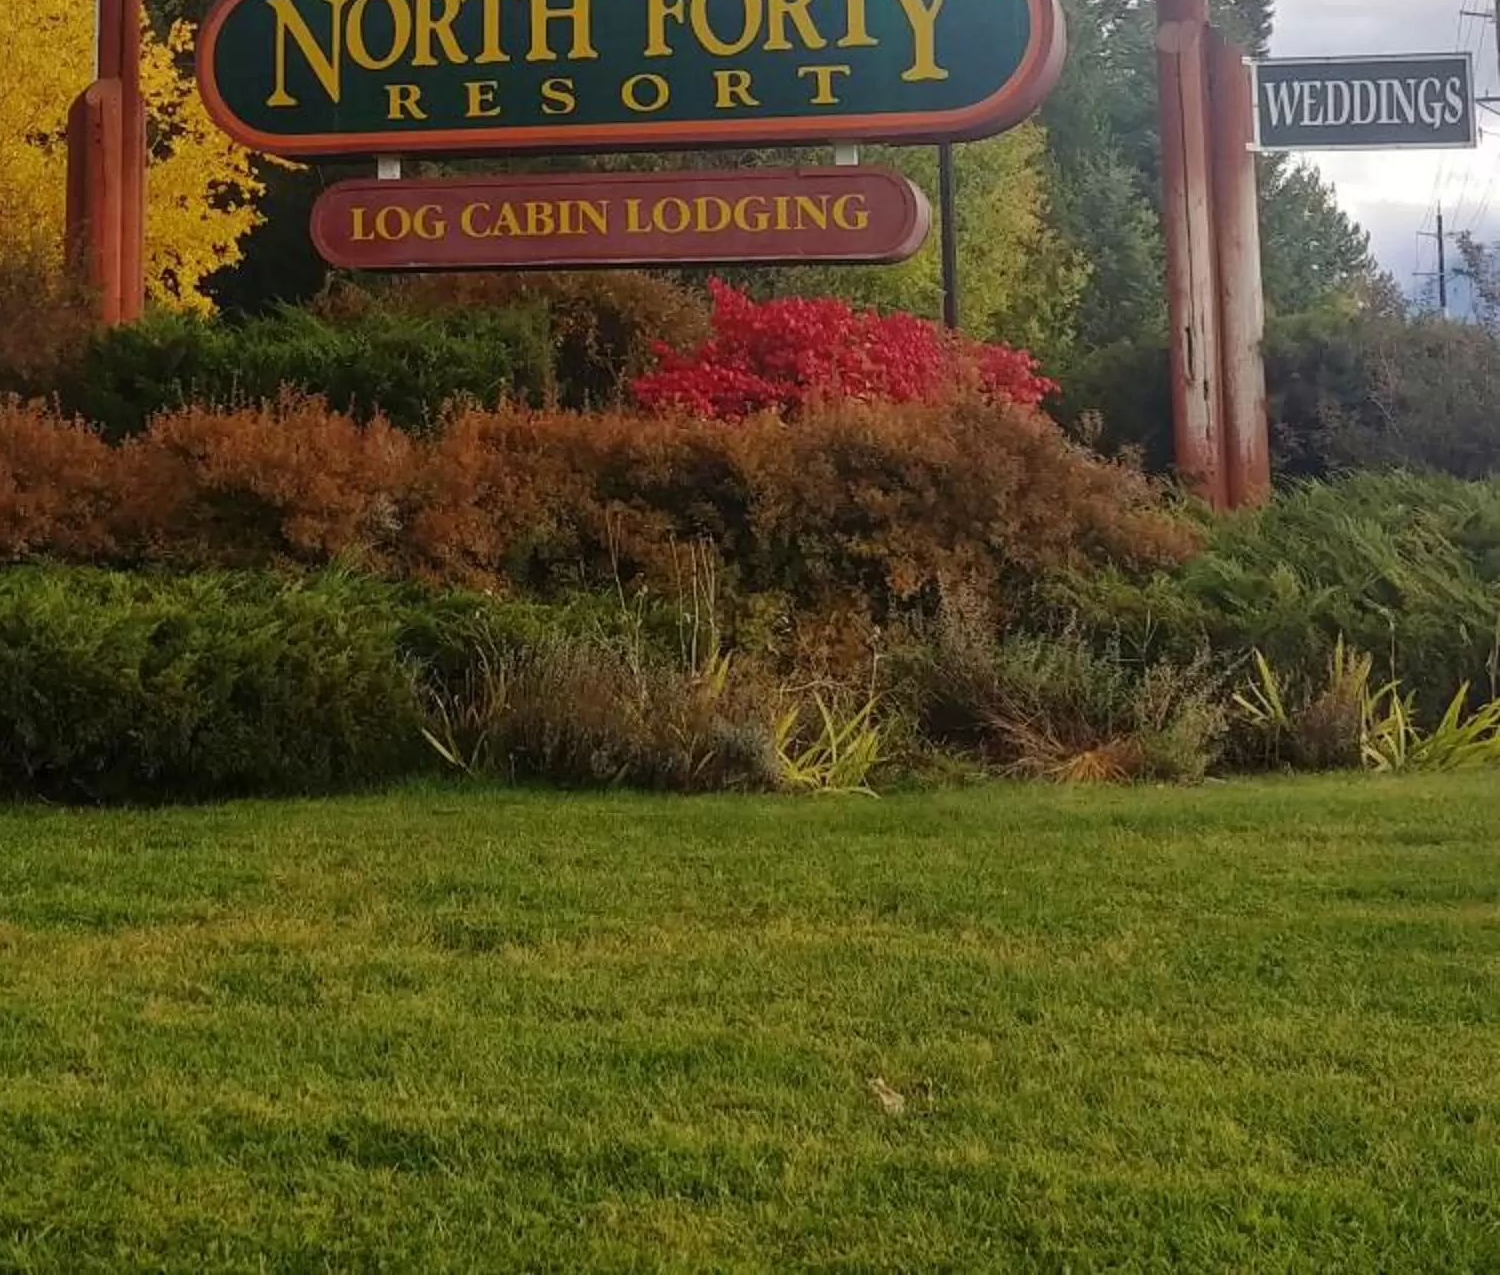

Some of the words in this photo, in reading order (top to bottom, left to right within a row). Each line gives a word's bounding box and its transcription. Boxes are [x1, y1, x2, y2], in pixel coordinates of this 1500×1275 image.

[386, 66, 850, 120] RESORT
[1263, 77, 1463, 129] WEDDINGS
[351, 204, 446, 240] LOG
[461, 200, 609, 238] CABIN
[626, 194, 870, 233] LODGING
